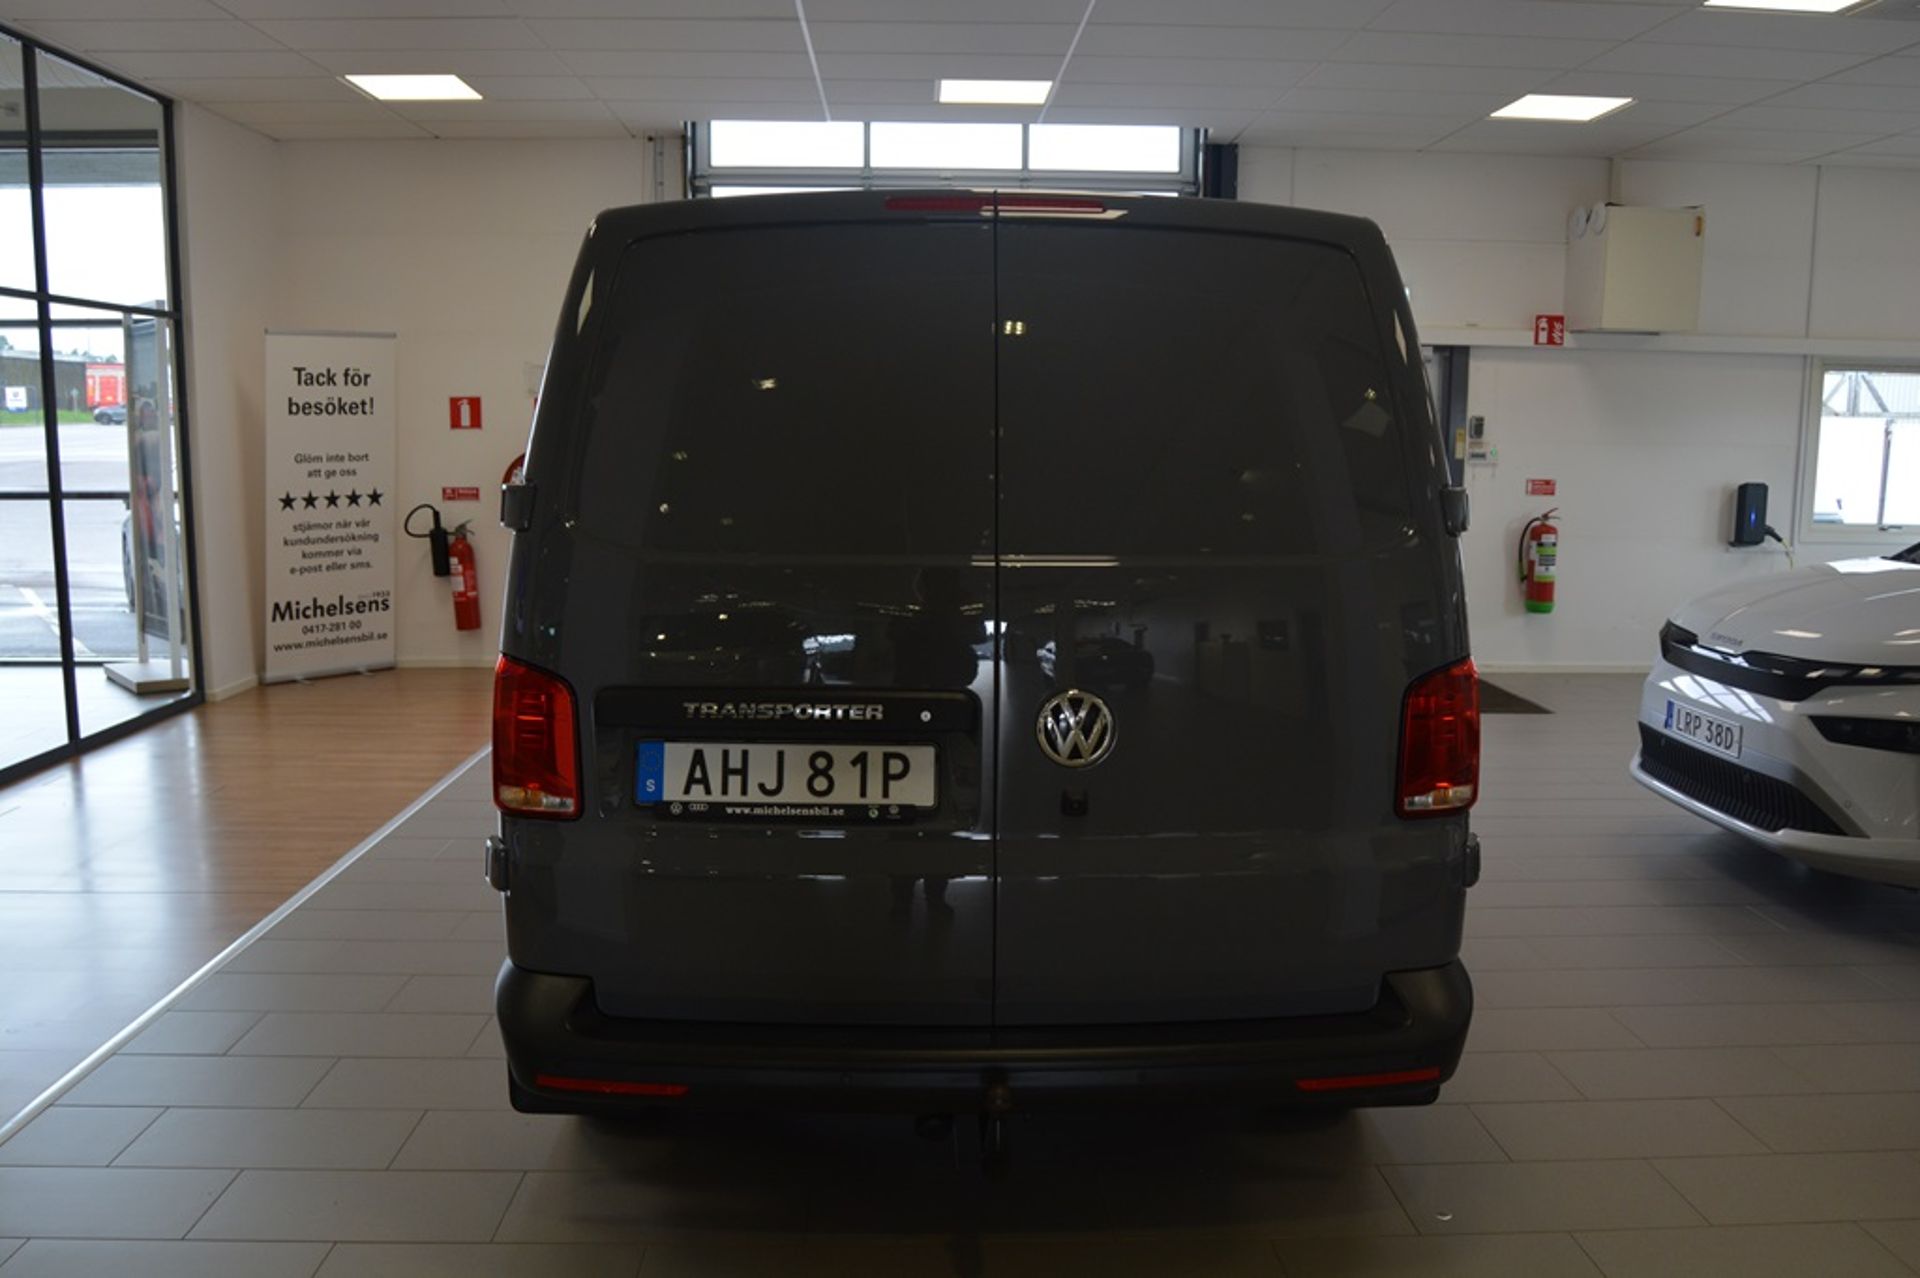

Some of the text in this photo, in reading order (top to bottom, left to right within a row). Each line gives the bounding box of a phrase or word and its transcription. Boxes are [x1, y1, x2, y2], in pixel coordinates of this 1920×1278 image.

[293, 366, 371, 387] Tack för
[288, 396, 375, 416] besöket!
[294, 452, 370, 464] Glöm inte bort
[307, 468, 357, 480] att ge oss
[292, 518, 370, 534] stjärnor när vår
[283, 532, 379, 547] kundundersökning
[301, 547, 362, 560] kommer via
[289, 560, 373, 576] e-post eller sms.
[271, 595, 391, 623] Michelsens
[302, 620, 362, 636] 0417-281 00
[273, 631, 388, 653] www.michelsensbil.se
[683, 702, 884, 720] TRANSPORTER
[1676, 707, 1734, 751] LRP 38D
[682, 748, 912, 799] AHJ 81P
[645, 778, 656, 792] S
[725, 804, 845, 817] www.michelsensbil.se
